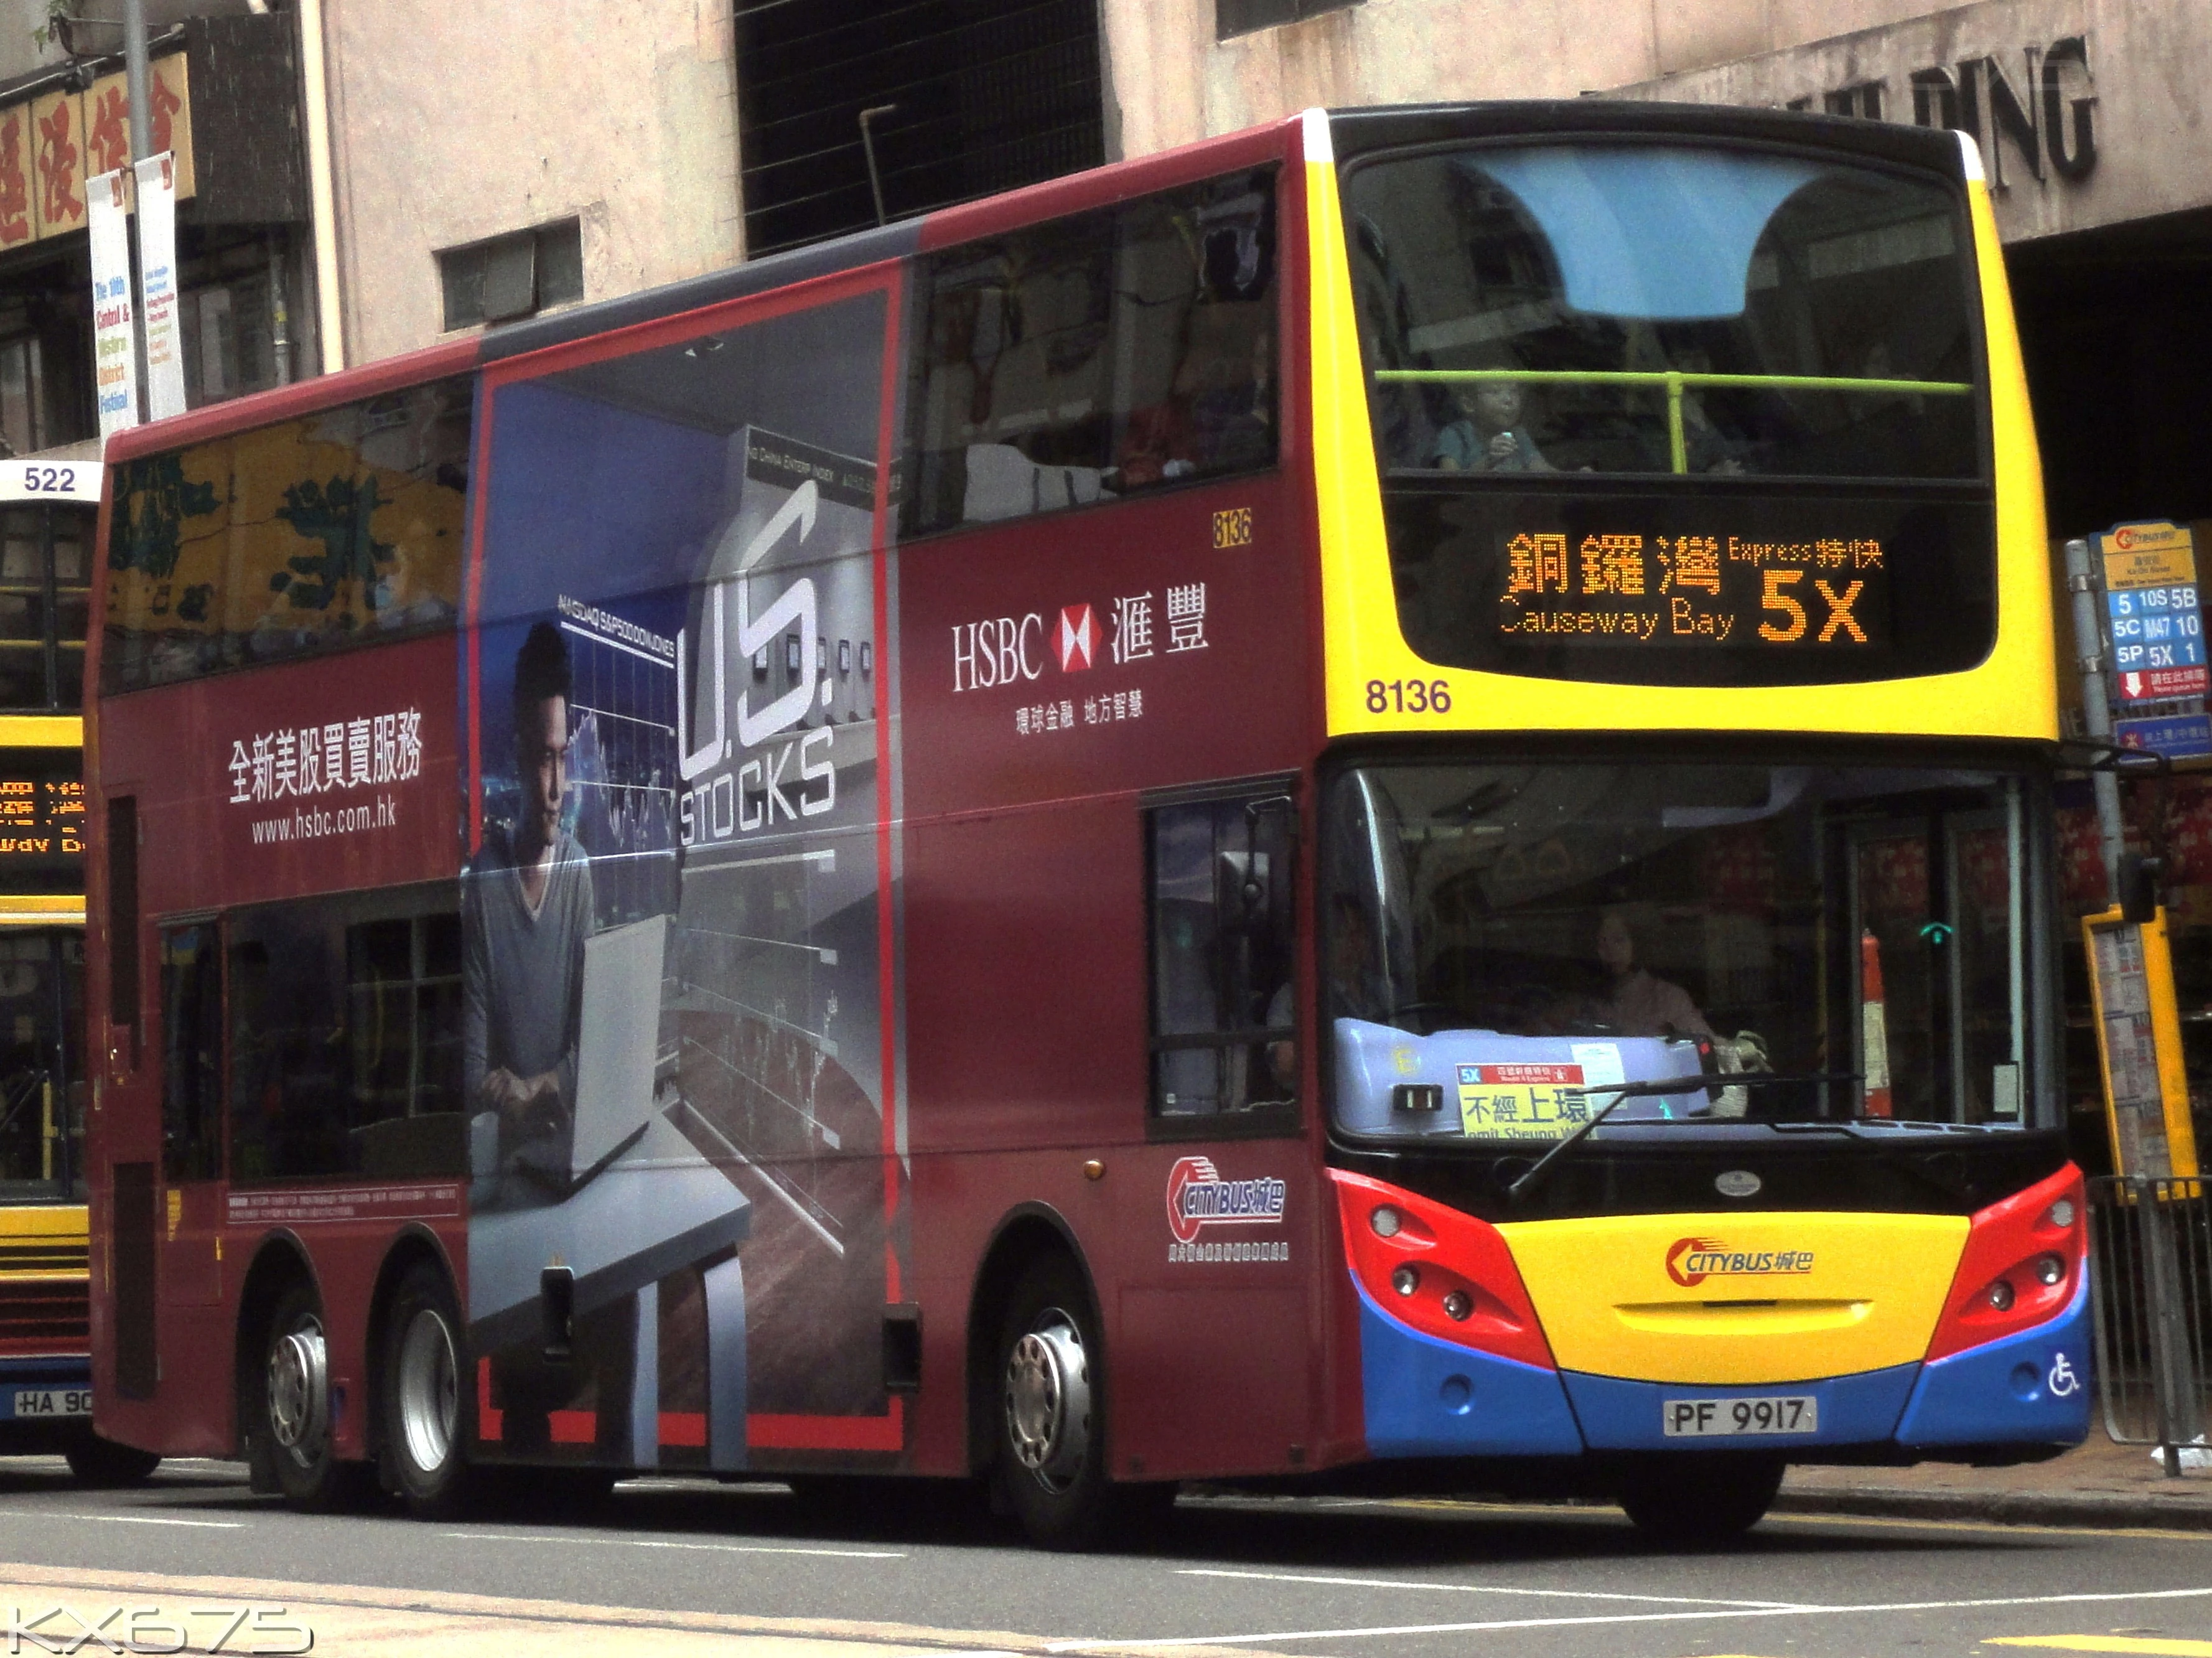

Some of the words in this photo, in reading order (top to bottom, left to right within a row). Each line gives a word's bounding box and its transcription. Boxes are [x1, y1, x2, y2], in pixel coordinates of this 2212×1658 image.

[25, 467, 75, 492] 522
[1213, 508, 1252, 548] 8136
[1507, 533, 1720, 594] 銅鑼灣
[1728, 536, 1812, 567] Express
[1815, 538, 1883, 569] 特快
[1500, 595, 1658, 640] Causeway
[1671, 597, 1735, 641] Bay
[1758, 569, 1869, 642] 5X
[2118, 594, 2132, 614] 5
[2139, 590, 2168, 607] 10S
[2171, 588, 2196, 609] 5B
[558, 593, 599, 632] NASDAQ
[651, 634, 676, 658] JONES
[2114, 618, 2140, 637] 5C
[951, 613, 1043, 691] HSBC
[2118, 644, 2144, 664] 5P
[2149, 644, 2173, 667] 5X
[2185, 643, 2196, 663] 1
[1016, 700, 1075, 735] 環球金融
[1084, 688, 1143, 725] 地方智慧
[1366, 678, 1452, 713] 8136
[229, 706, 423, 804] 全新美股買賣服務
[680, 725, 836, 846] STOCKS
[252, 794, 396, 844] www.hsbc.com.hk
[1460, 1067, 1480, 1083] 5X
[1464, 1087, 1589, 1124] 不經上環
[1184, 1182, 1253, 1215] CITYBUS
[1686, 1251, 1774, 1273] CITYBUS
[1775, 1250, 1814, 1271] 城巴
[22, 1393, 54, 1413] HA
[1676, 1402, 1715, 1432] PF
[1732, 1400, 1806, 1431] 9917
